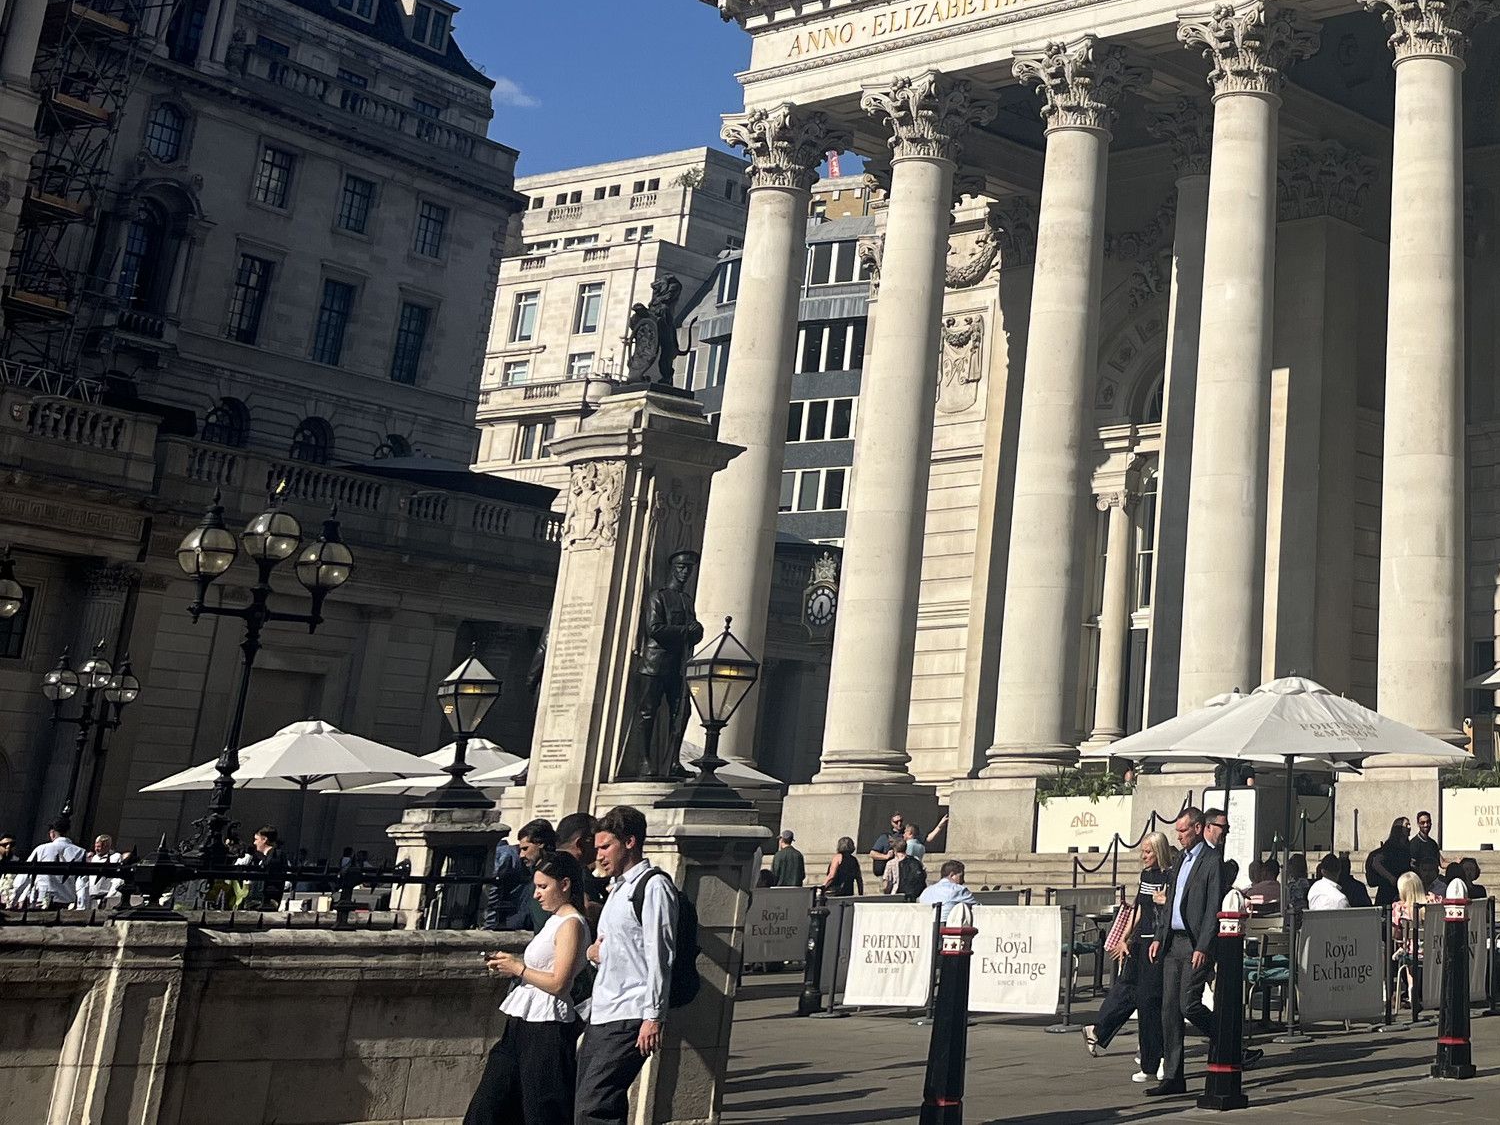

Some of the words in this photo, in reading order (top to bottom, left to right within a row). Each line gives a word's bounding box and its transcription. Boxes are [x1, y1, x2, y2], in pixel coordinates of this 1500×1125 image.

[787, 22, 854, 58] ANNO
[761, 908, 788, 925] Royal
[752, 923, 799, 939] Exchange
[862, 935, 920, 949] FORTNUM
[995, 936, 1033, 959] Royal
[1325, 938, 1358, 963] Royal
[982, 956, 1046, 981] Exchange
[1312, 961, 1373, 984] Exchange
